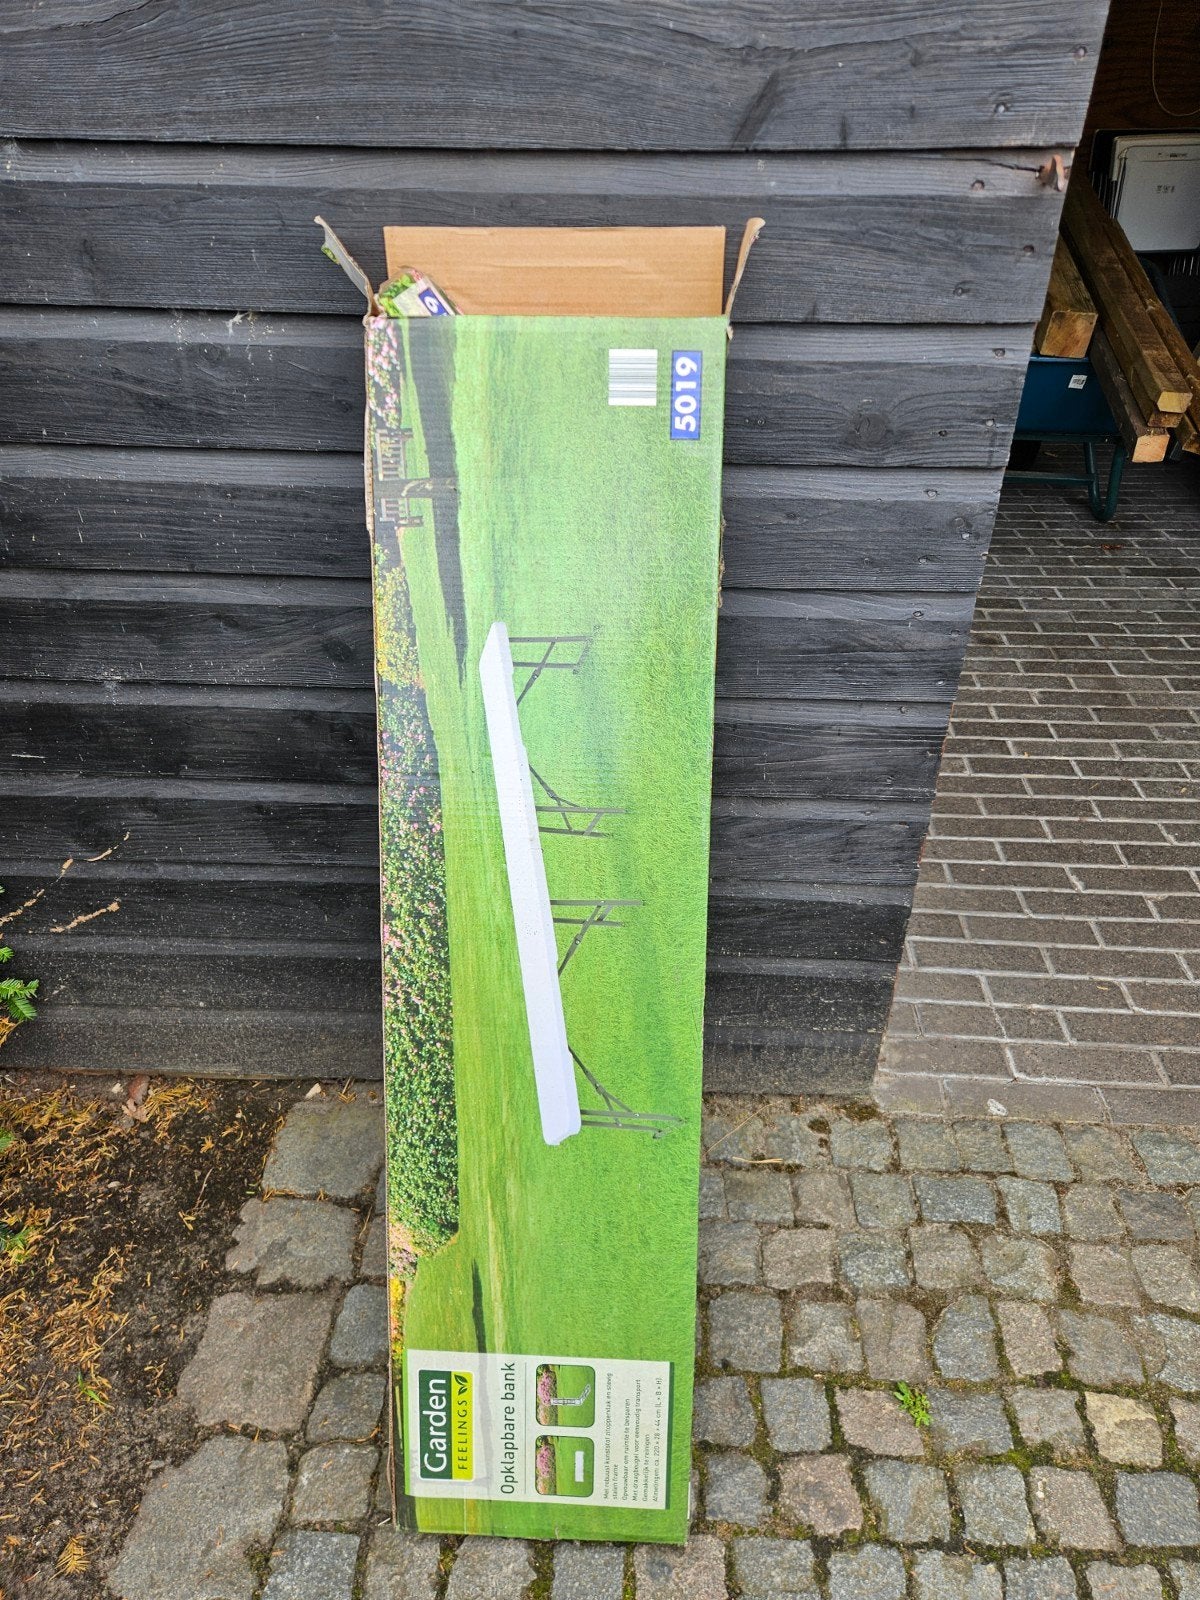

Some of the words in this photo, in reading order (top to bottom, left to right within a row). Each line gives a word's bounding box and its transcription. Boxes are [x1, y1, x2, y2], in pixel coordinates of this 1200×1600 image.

[674, 357, 698, 432] 5019
[501, 1363, 515, 1400] bank
[656, 1409, 661, 1418] cm
[424, 1378, 447, 1472] Garden
[457, 1400, 468, 1469] FEELINGS
[501, 1406, 518, 1494] Opklapbare
[624, 1456, 628, 1464] om
